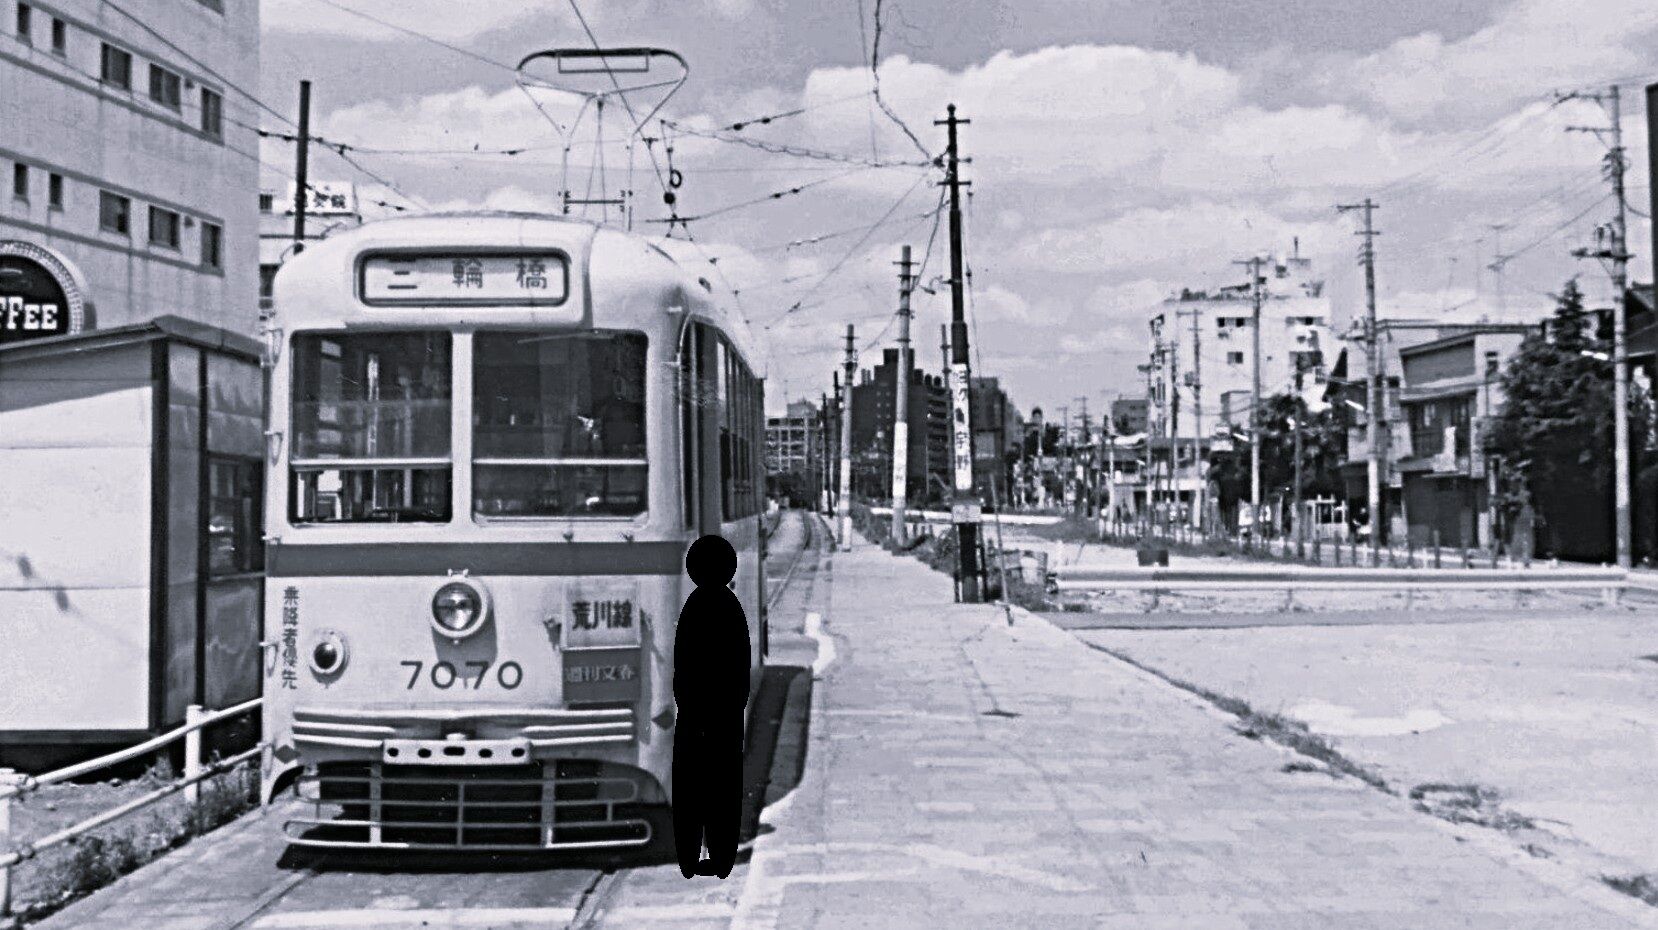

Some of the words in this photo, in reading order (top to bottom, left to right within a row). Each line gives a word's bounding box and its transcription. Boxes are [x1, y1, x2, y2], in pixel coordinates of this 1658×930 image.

[572, 599, 632, 630] 荒川線
[400, 660, 523, 690] 7070
